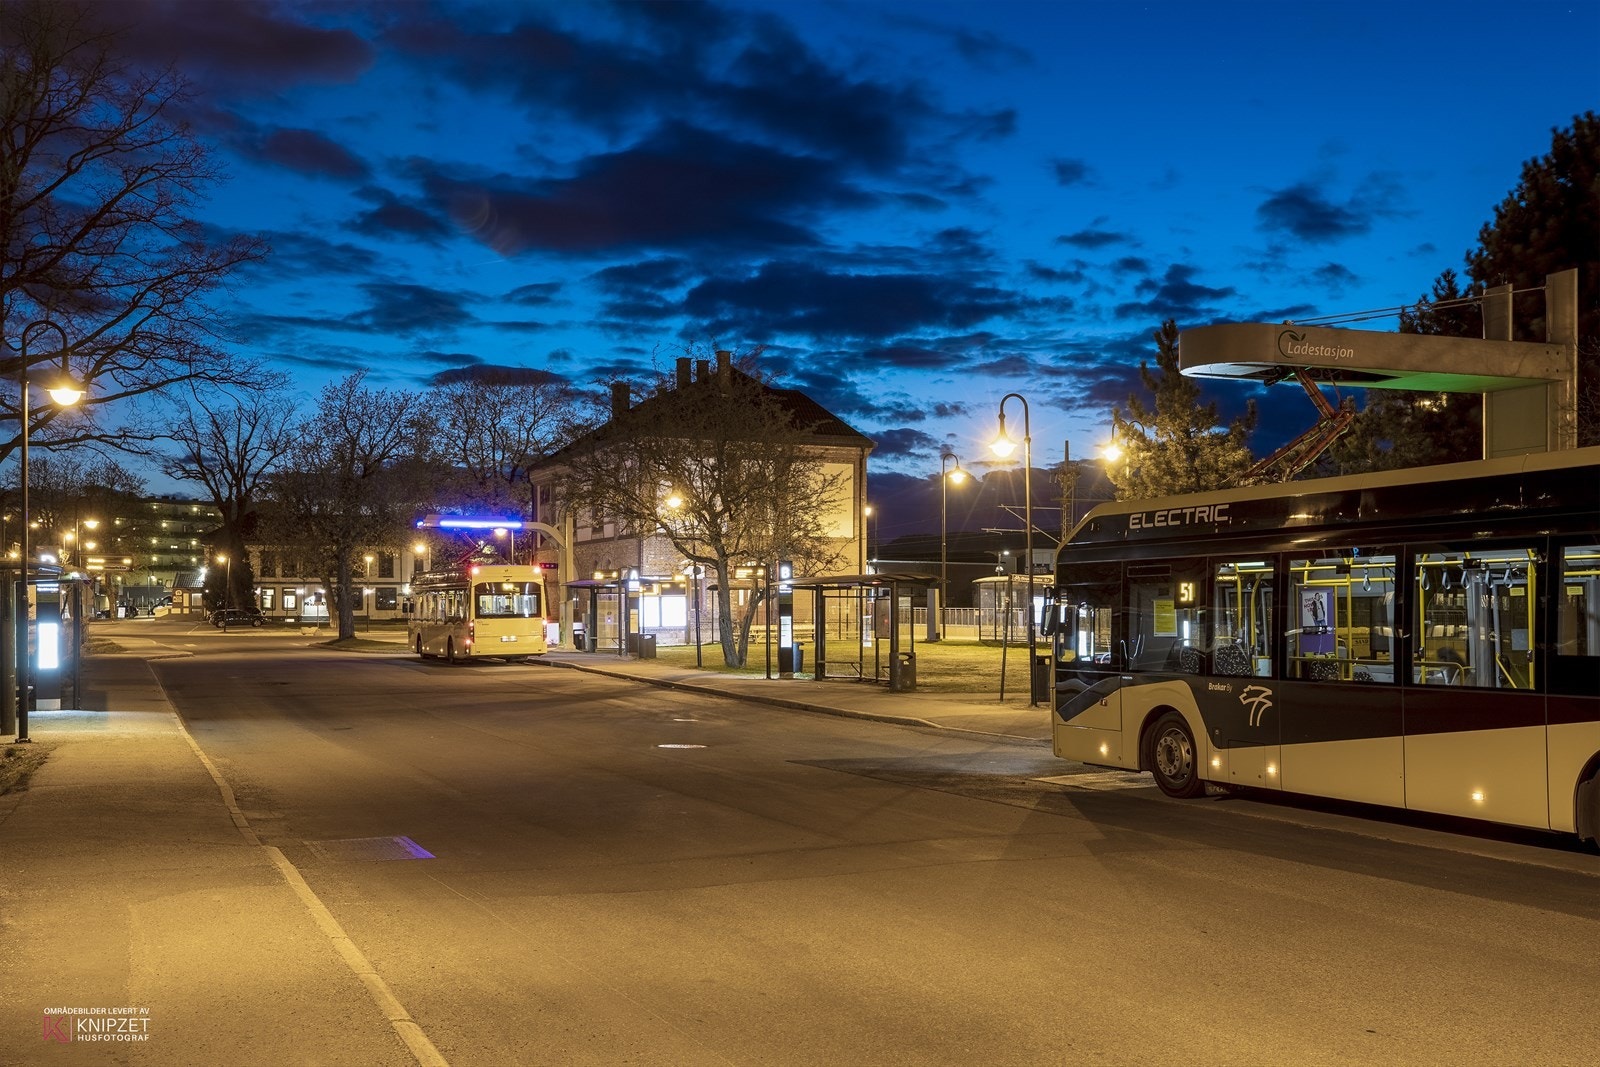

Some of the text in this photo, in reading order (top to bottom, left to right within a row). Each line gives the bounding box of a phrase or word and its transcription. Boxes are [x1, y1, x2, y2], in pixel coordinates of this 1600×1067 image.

[1287, 341, 1354, 360] Ladestasjon
[1129, 504, 1230, 529] ELECTRIC
[1180, 582, 1194, 602] 51
